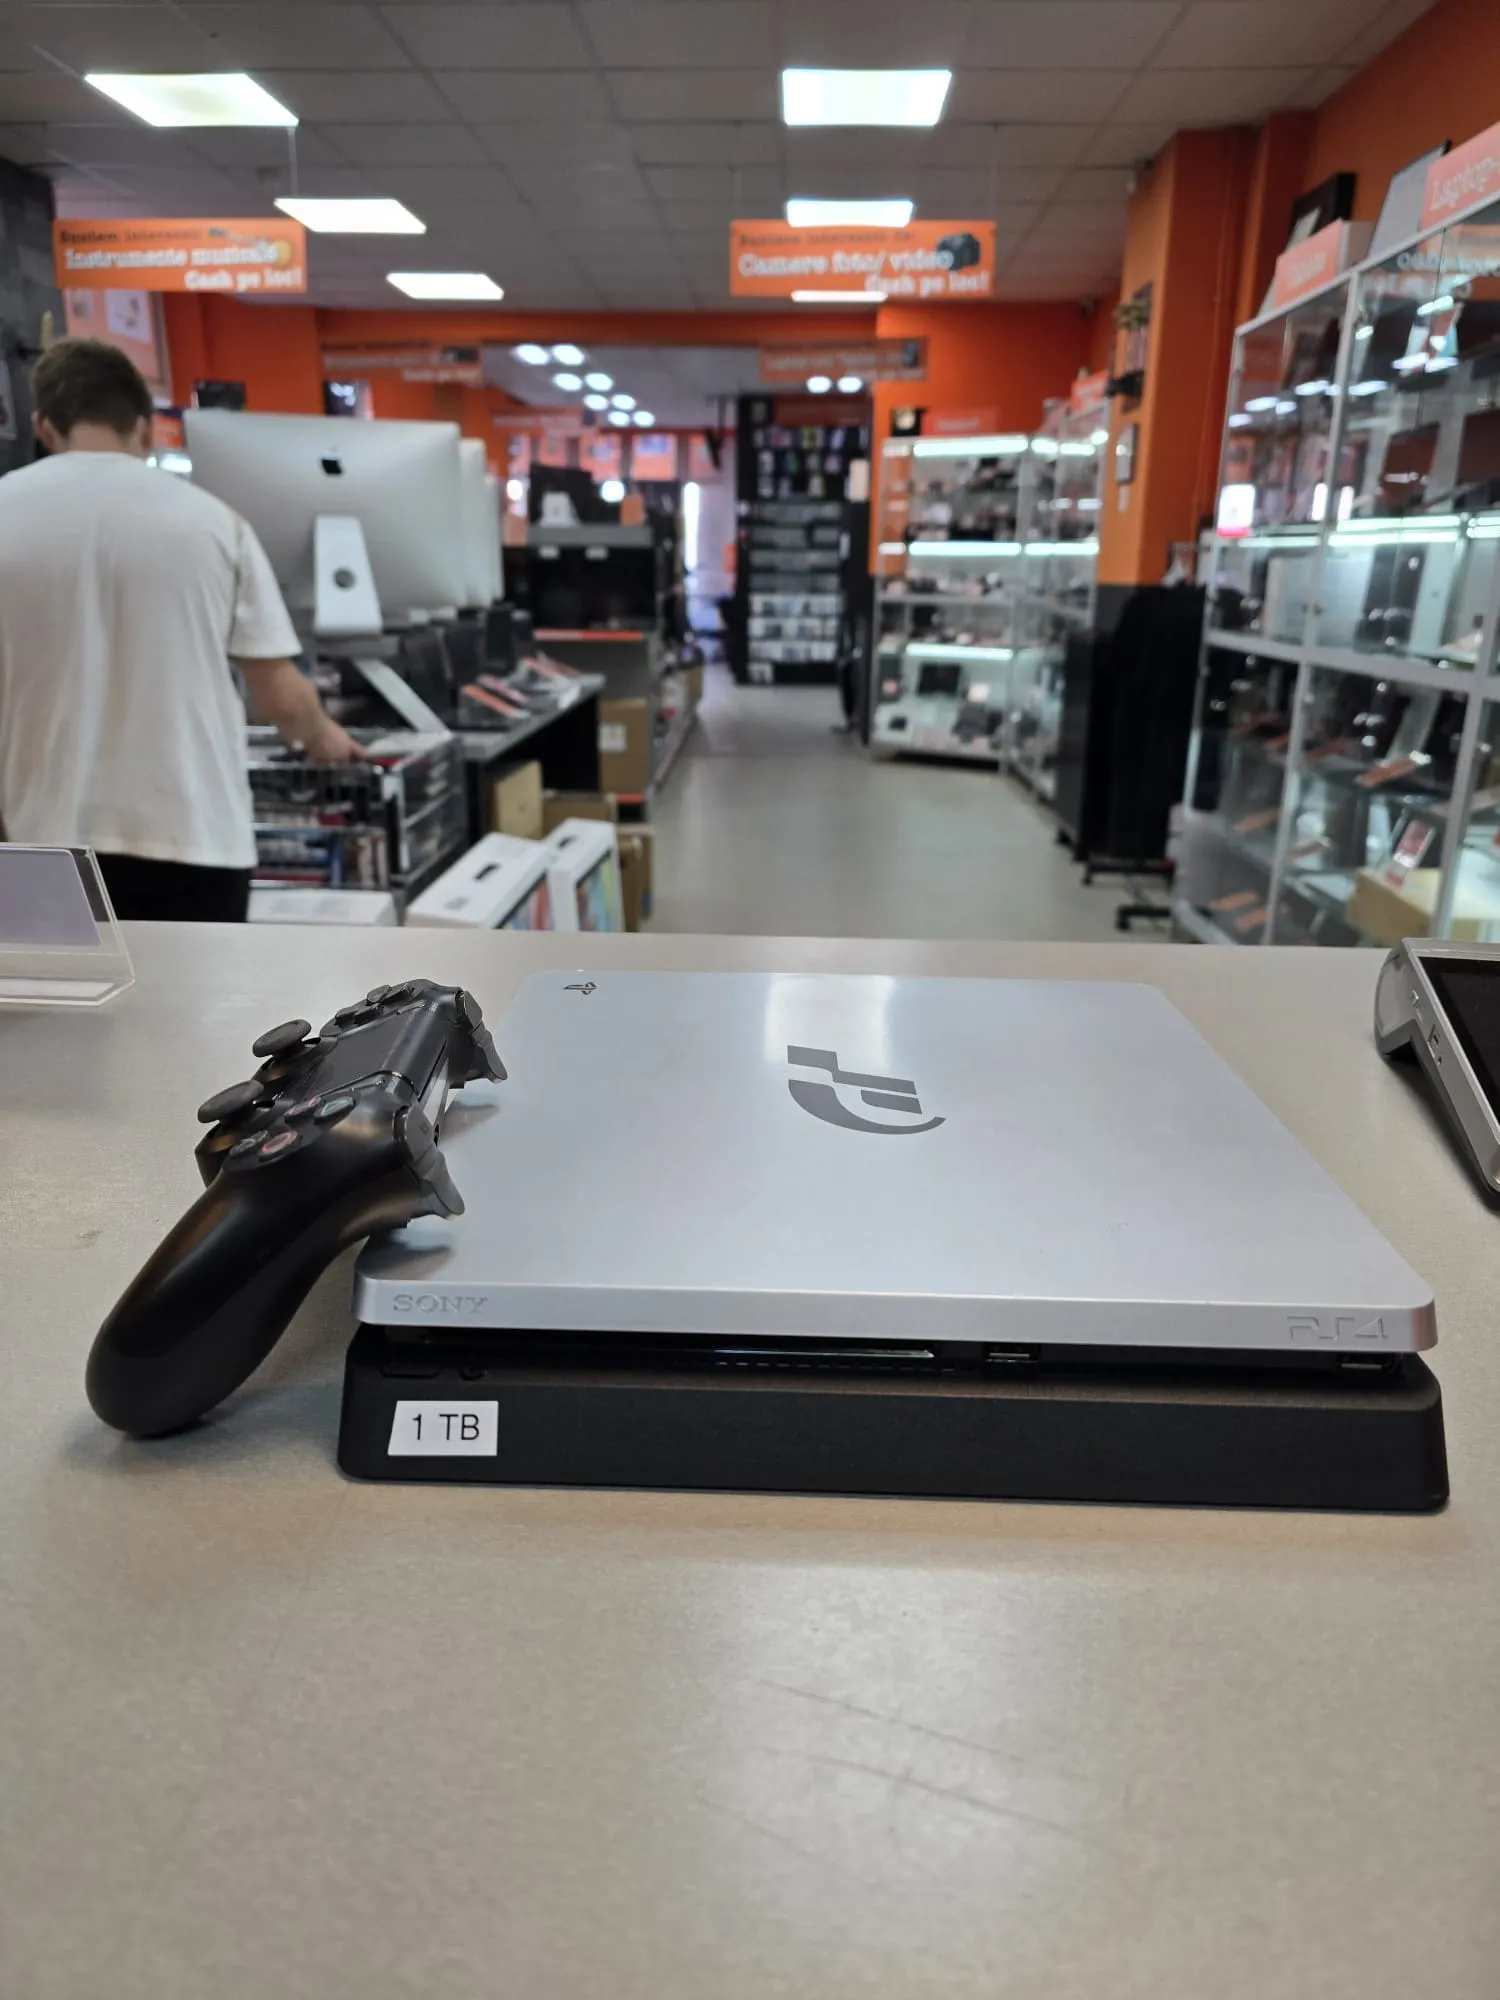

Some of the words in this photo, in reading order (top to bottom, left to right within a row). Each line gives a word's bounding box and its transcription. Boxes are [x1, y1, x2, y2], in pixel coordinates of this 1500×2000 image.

[393, 1293, 488, 1313] SONY
[1287, 1315, 1389, 1341] PS4
[412, 1413, 422, 1441] 1
[439, 1413, 480, 1441] TB
